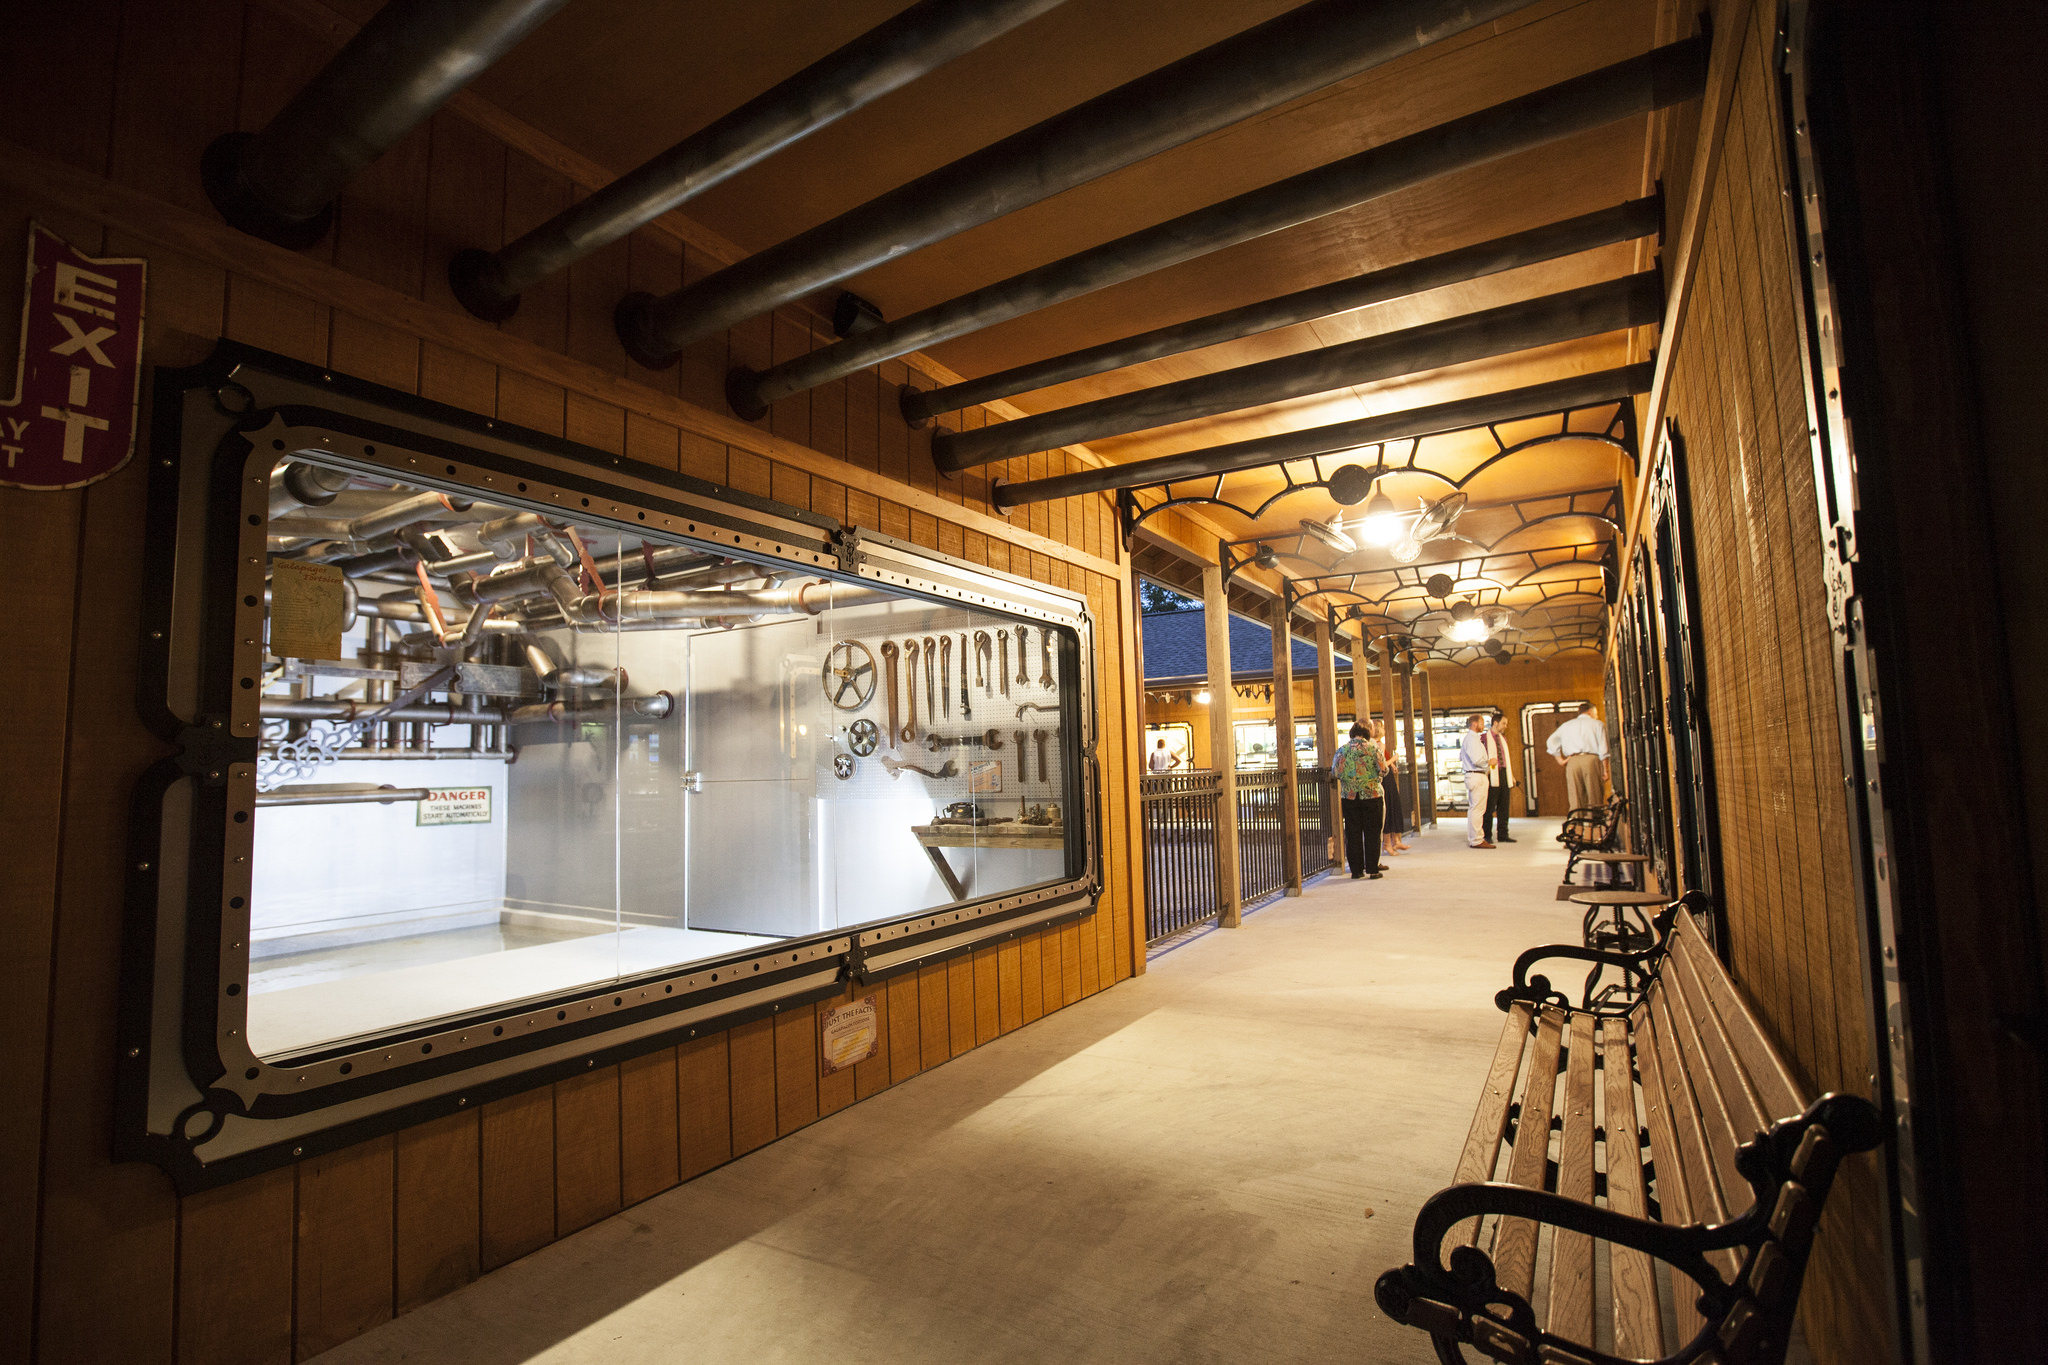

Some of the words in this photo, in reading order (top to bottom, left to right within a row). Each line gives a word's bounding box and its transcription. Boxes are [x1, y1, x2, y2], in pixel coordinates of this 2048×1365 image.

[41, 261, 118, 464] EXIT
[427, 791, 486, 801] DANGER
[825, 1015, 841, 1028] JUST
[842, 1010, 855, 1020] THE
[855, 1005, 873, 1016] FACTS
